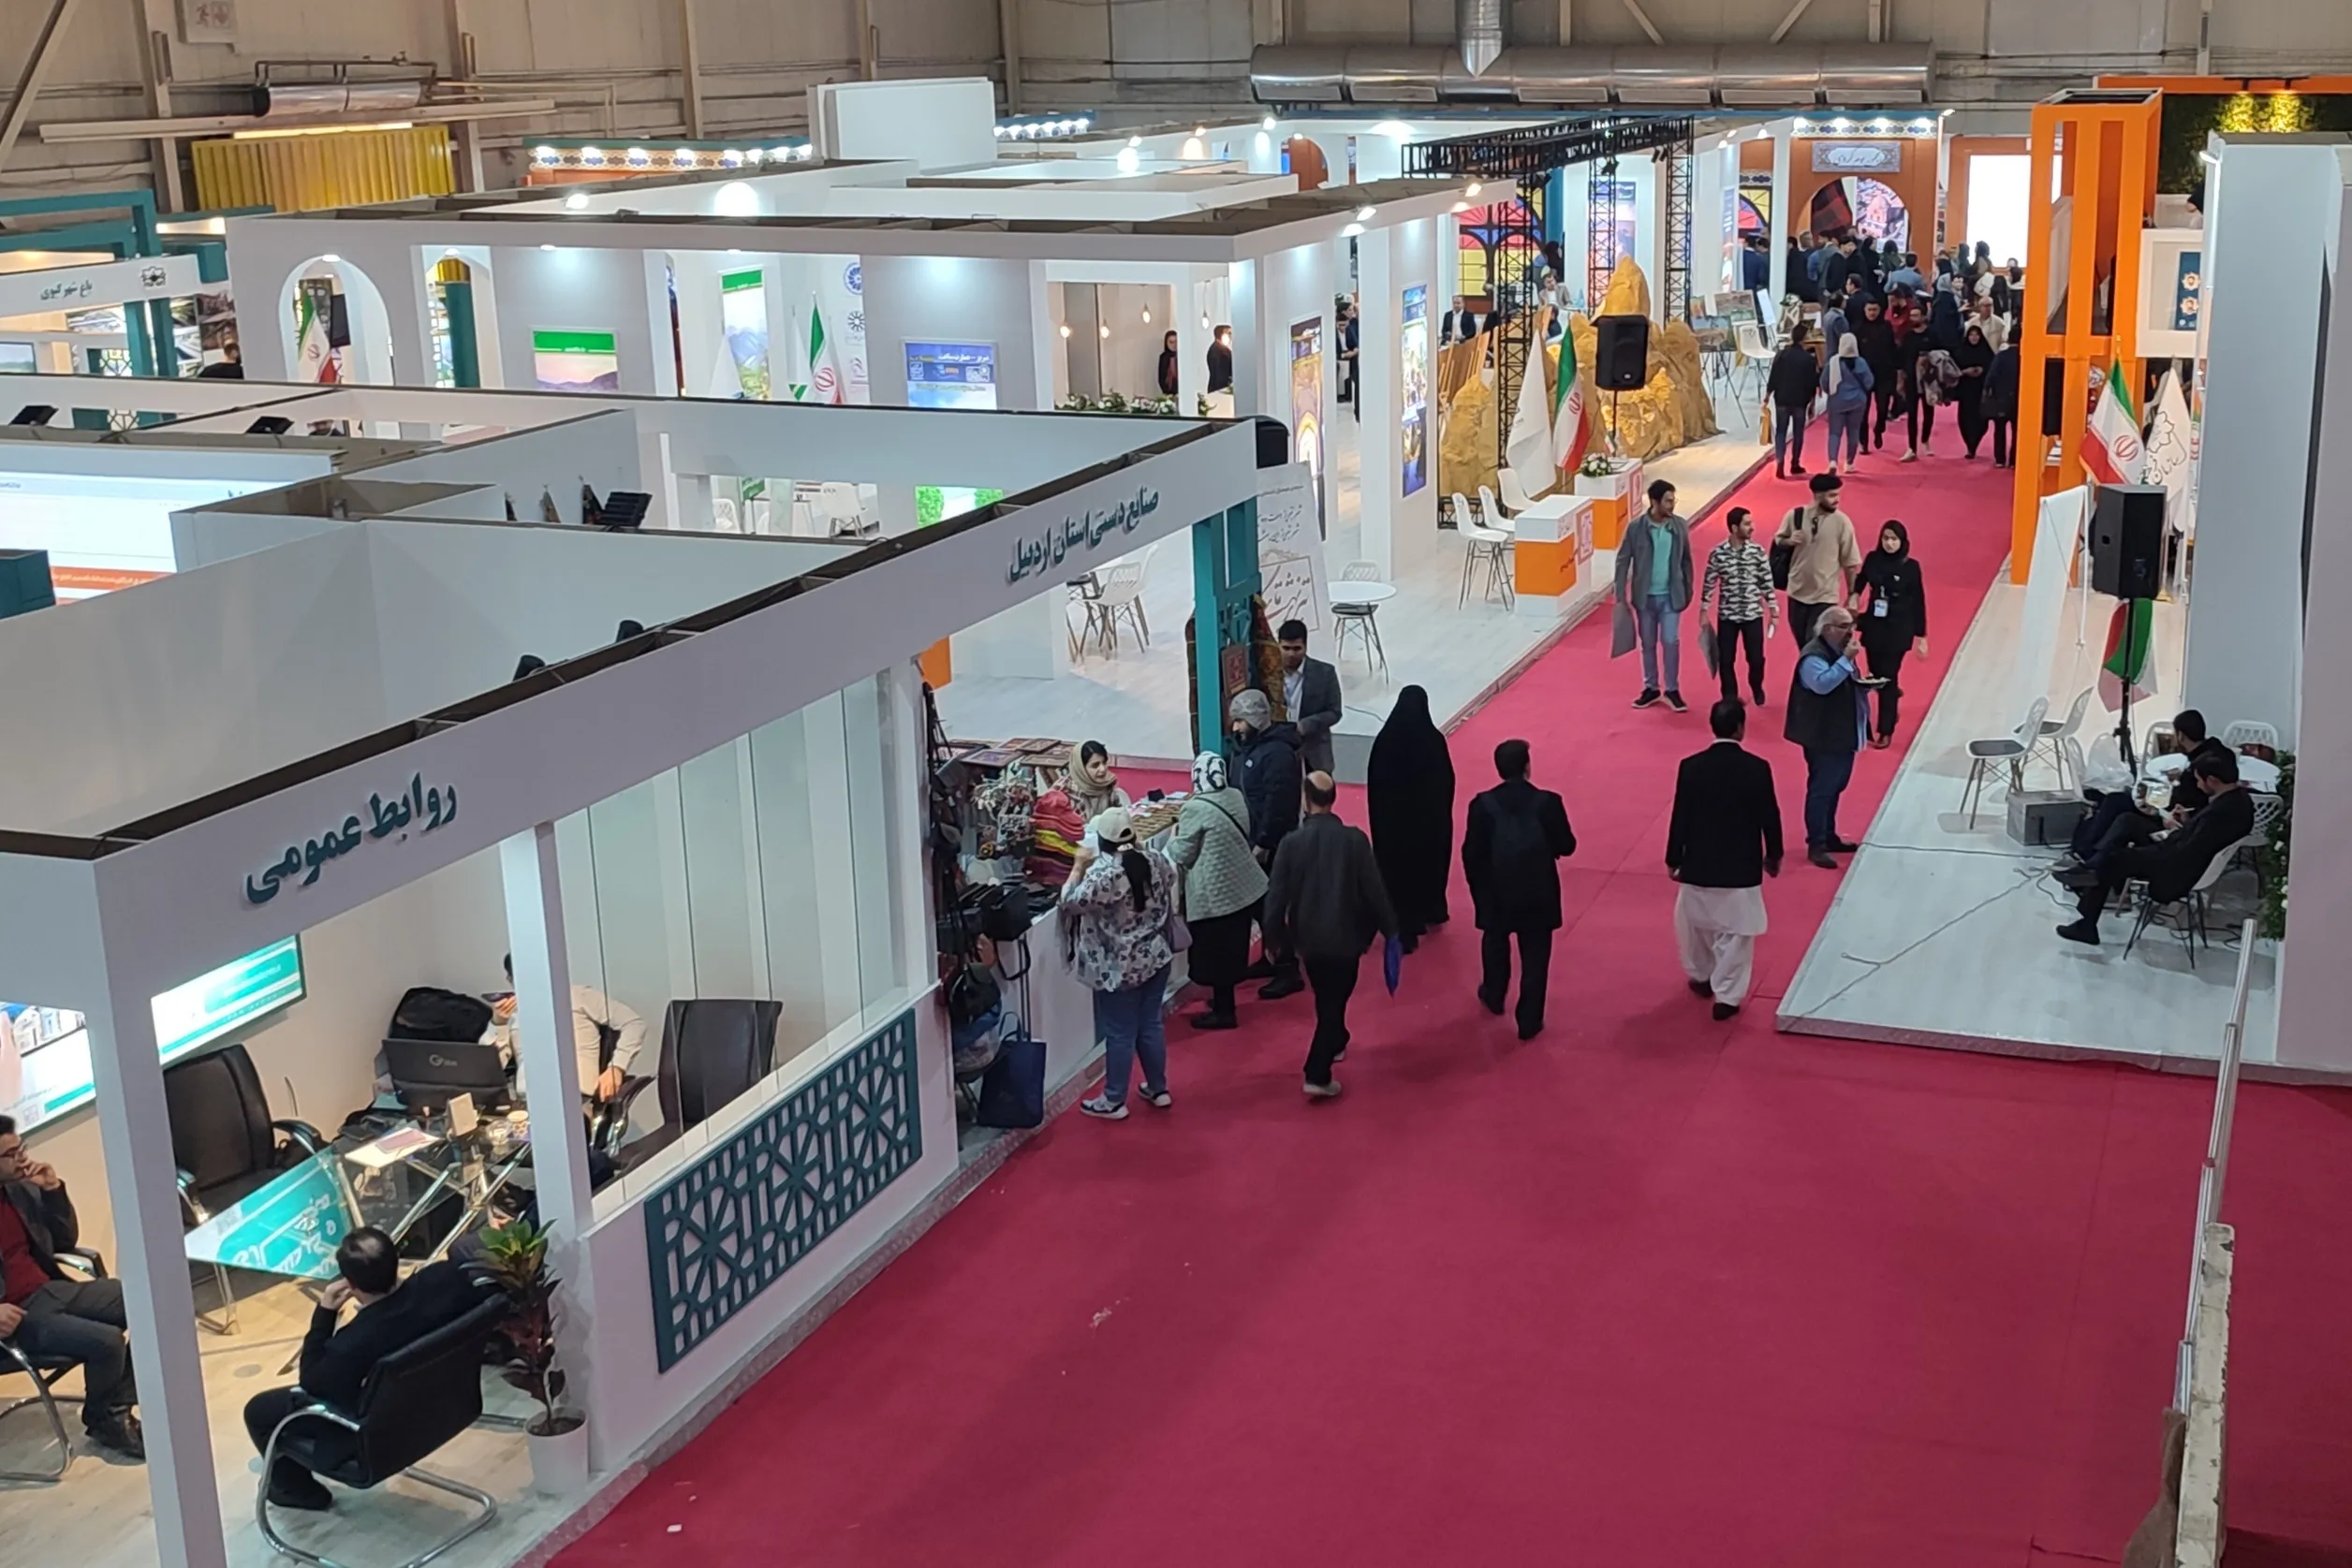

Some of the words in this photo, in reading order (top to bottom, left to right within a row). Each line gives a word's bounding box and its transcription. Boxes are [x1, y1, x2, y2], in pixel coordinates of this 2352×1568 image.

[63, 281, 79, 298] شهر
[1090, 502, 1125, 547] دستی
[1125, 485, 1159, 531] صنایع
[1009, 527, 1051, 582] اردبیل
[1052, 510, 1090, 565] استان
[368, 771, 457, 842] روابط
[245, 815, 362, 904] عمومی
